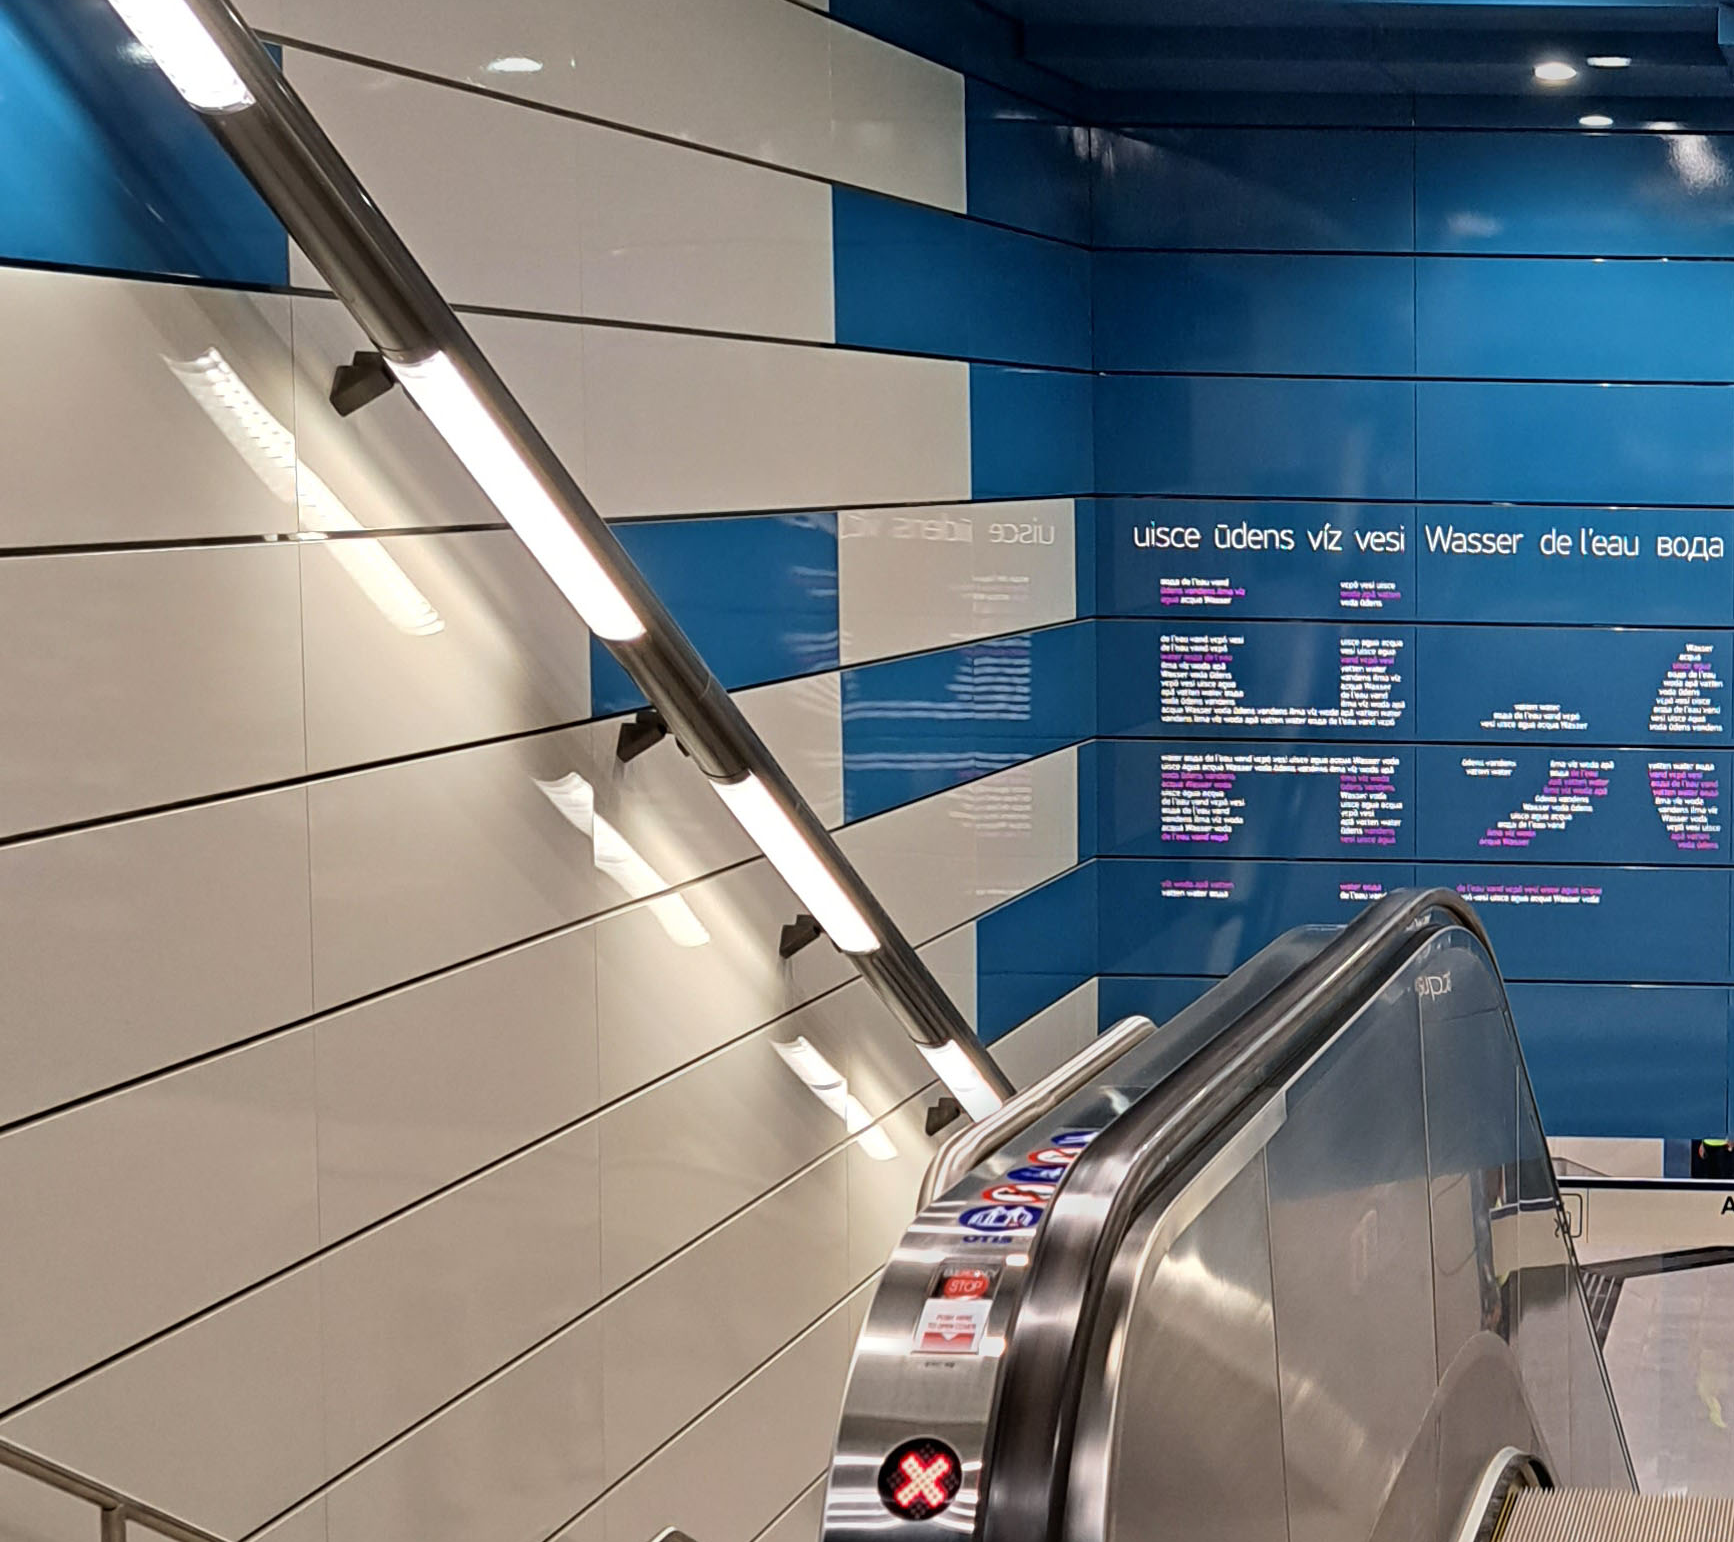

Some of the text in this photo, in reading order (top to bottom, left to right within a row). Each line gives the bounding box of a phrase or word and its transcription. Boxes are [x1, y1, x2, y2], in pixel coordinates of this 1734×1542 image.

[1134, 521, 1201, 548] uisce
[1215, 521, 1294, 550] ūdens
[1307, 523, 1342, 551] víz
[1354, 525, 1405, 552] vesi
[1425, 525, 1523, 554] Wasser
[1657, 536, 1723, 561] вода
[949, 1280, 984, 1293] STOP
